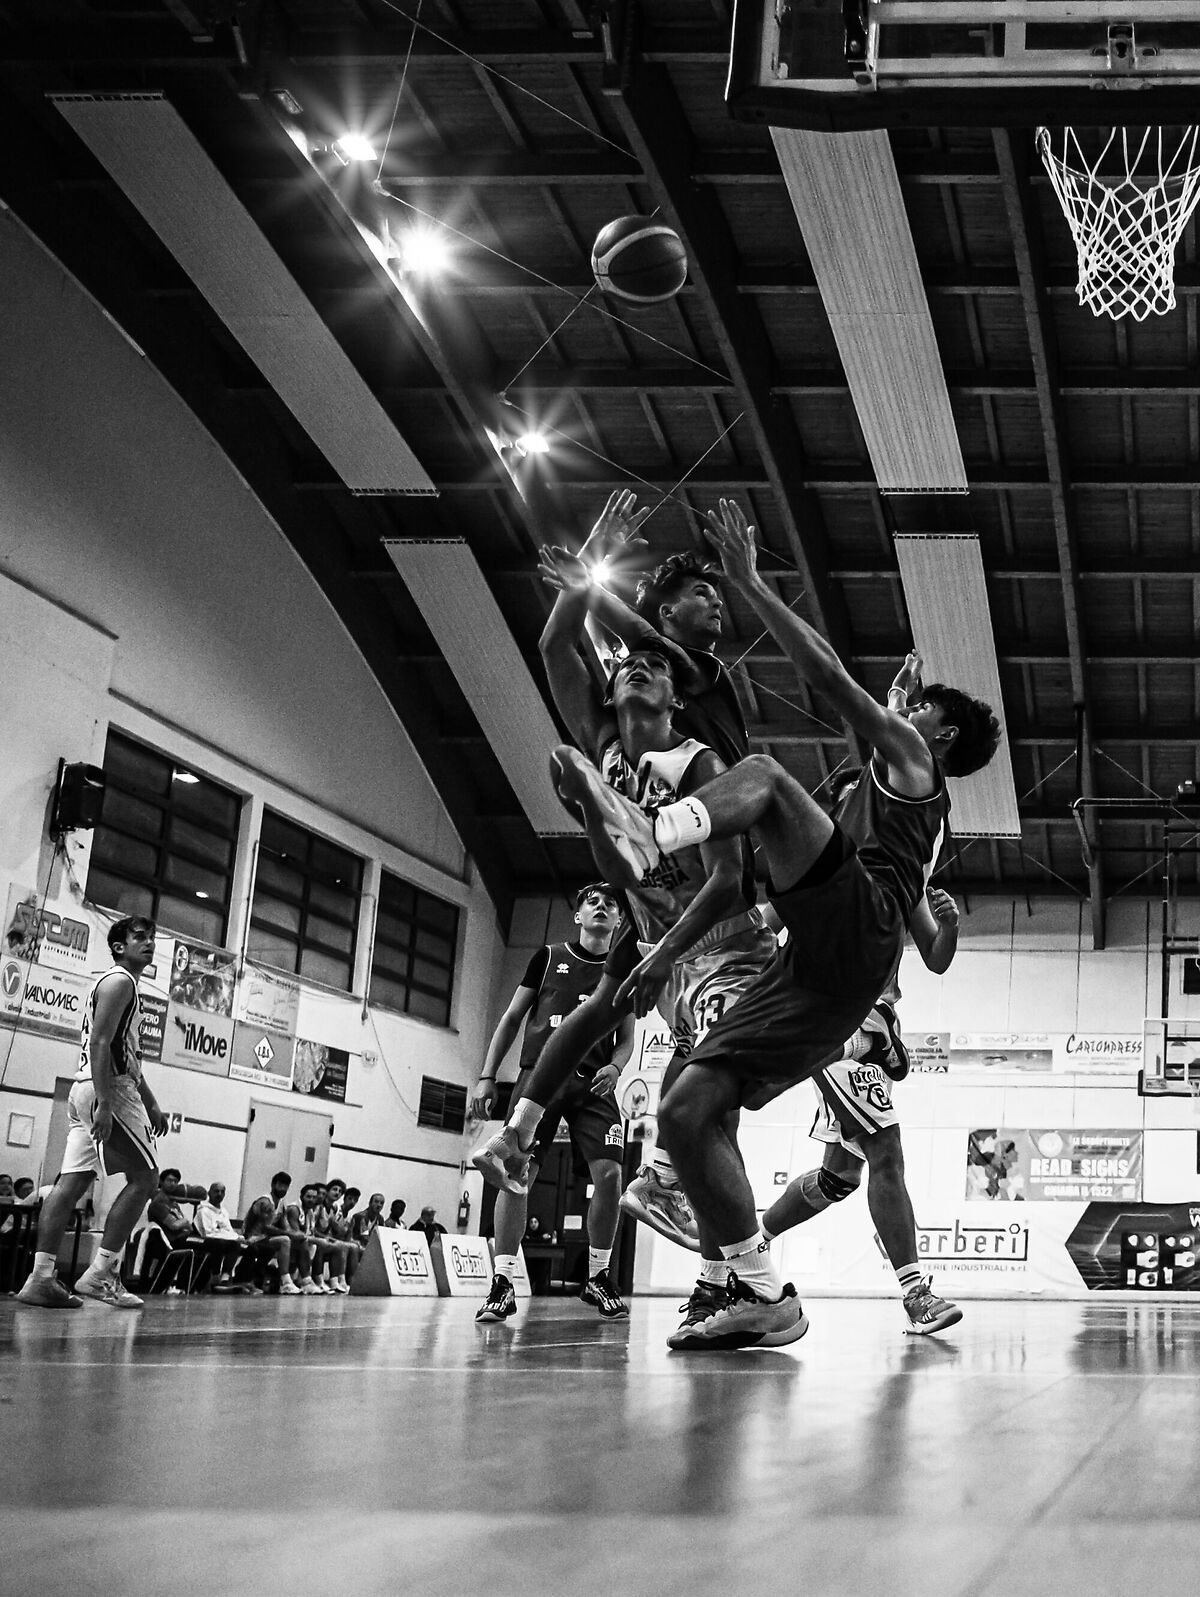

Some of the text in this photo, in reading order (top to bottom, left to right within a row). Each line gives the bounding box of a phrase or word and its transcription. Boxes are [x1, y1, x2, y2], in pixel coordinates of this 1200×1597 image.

[185, 1022, 228, 1058] iMove
[1030, 1158, 1072, 1176] READ
[1080, 1158, 1129, 1177] SIGNS
[918, 1219, 1021, 1253] arberi
[951, 1263, 1008, 1272] INDUSTRIALI
